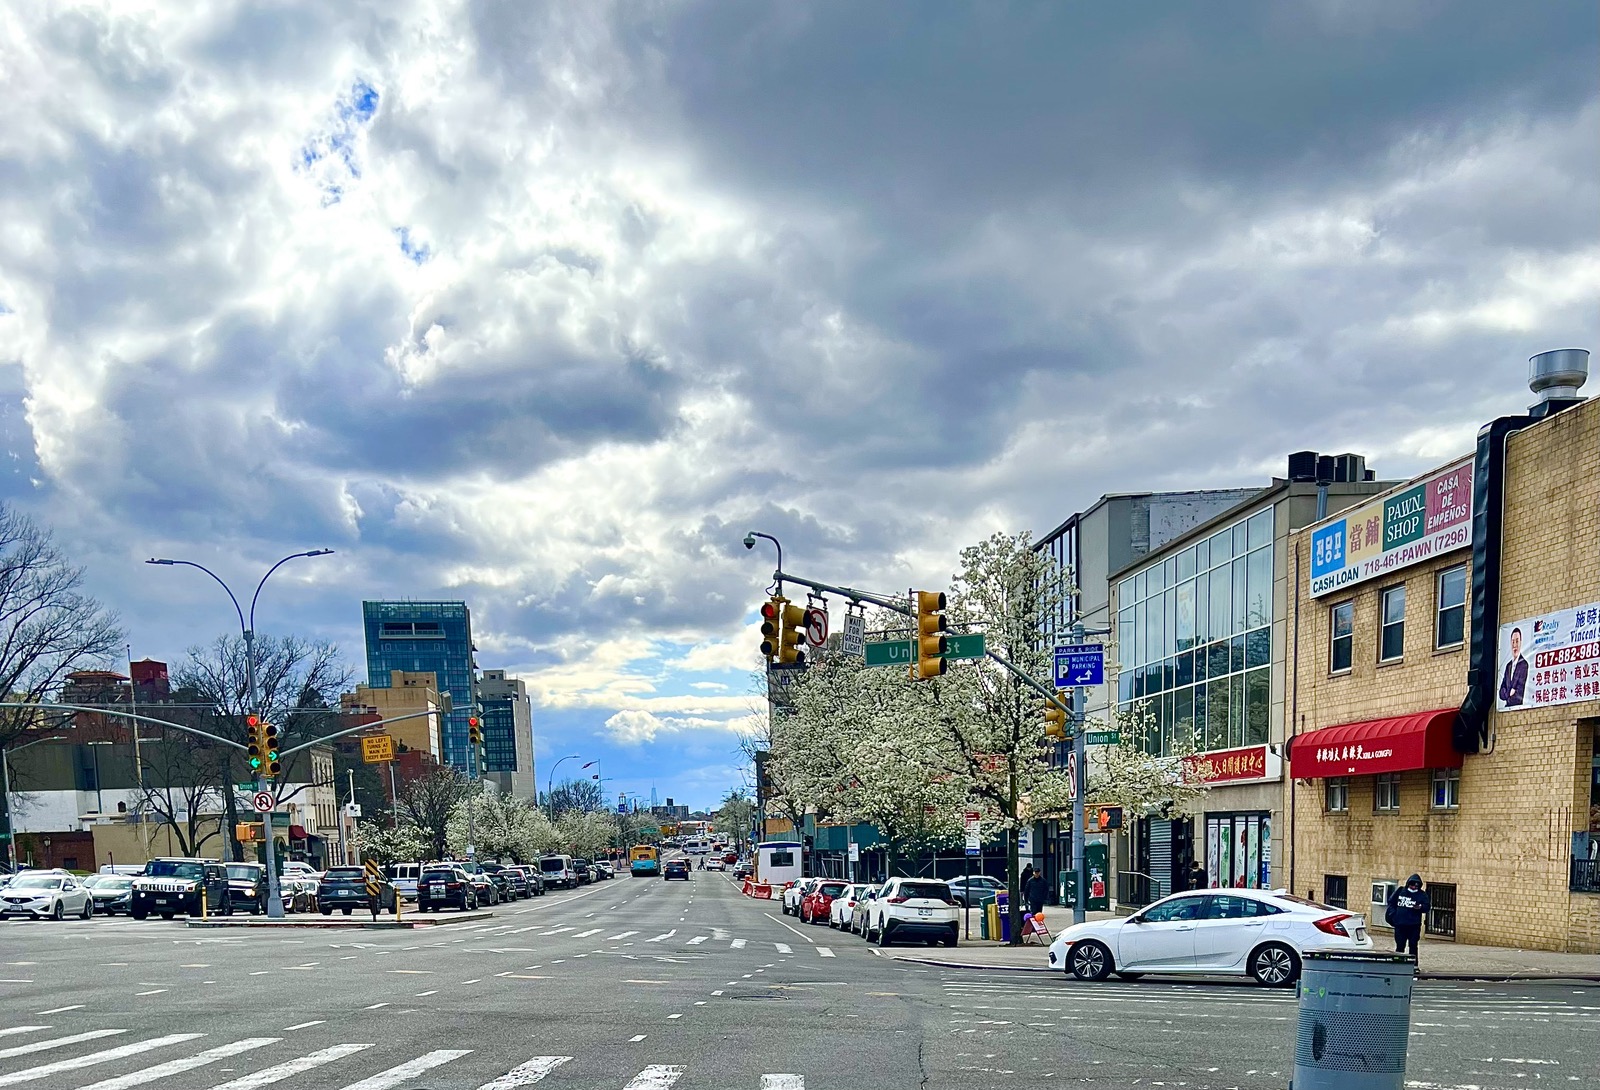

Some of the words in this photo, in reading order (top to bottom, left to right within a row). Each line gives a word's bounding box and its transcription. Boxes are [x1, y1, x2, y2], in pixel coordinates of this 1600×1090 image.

[1437, 474, 1460, 495] CASA
[1387, 494, 1423, 522] PAWN
[1441, 493, 1454, 509] DE
[1427, 503, 1468, 530] EMPEÑOS
[1387, 516, 1420, 543] SHOP
[1313, 575, 1335, 594] CASH
[1336, 566, 1359, 586] LOAN
[1364, 540, 1431, 576] 718-461-PAWN
[1434, 526, 1468, 552] (7296)
[849, 617, 862, 627] WAIT
[1575, 606, 1600, 628] 施晓
[849, 626, 860, 635] FOR
[1570, 627, 1597, 643] Vincent
[845, 633, 862, 645] GREEN
[845, 642, 860, 653] LIGHT
[889, 645, 920, 659] Uni
[1071, 655, 1101, 663] MUNICIPAL
[1071, 662, 1096, 670] PARKING
[1058, 664, 1069, 679] P
[1088, 733, 1109, 744] Union
